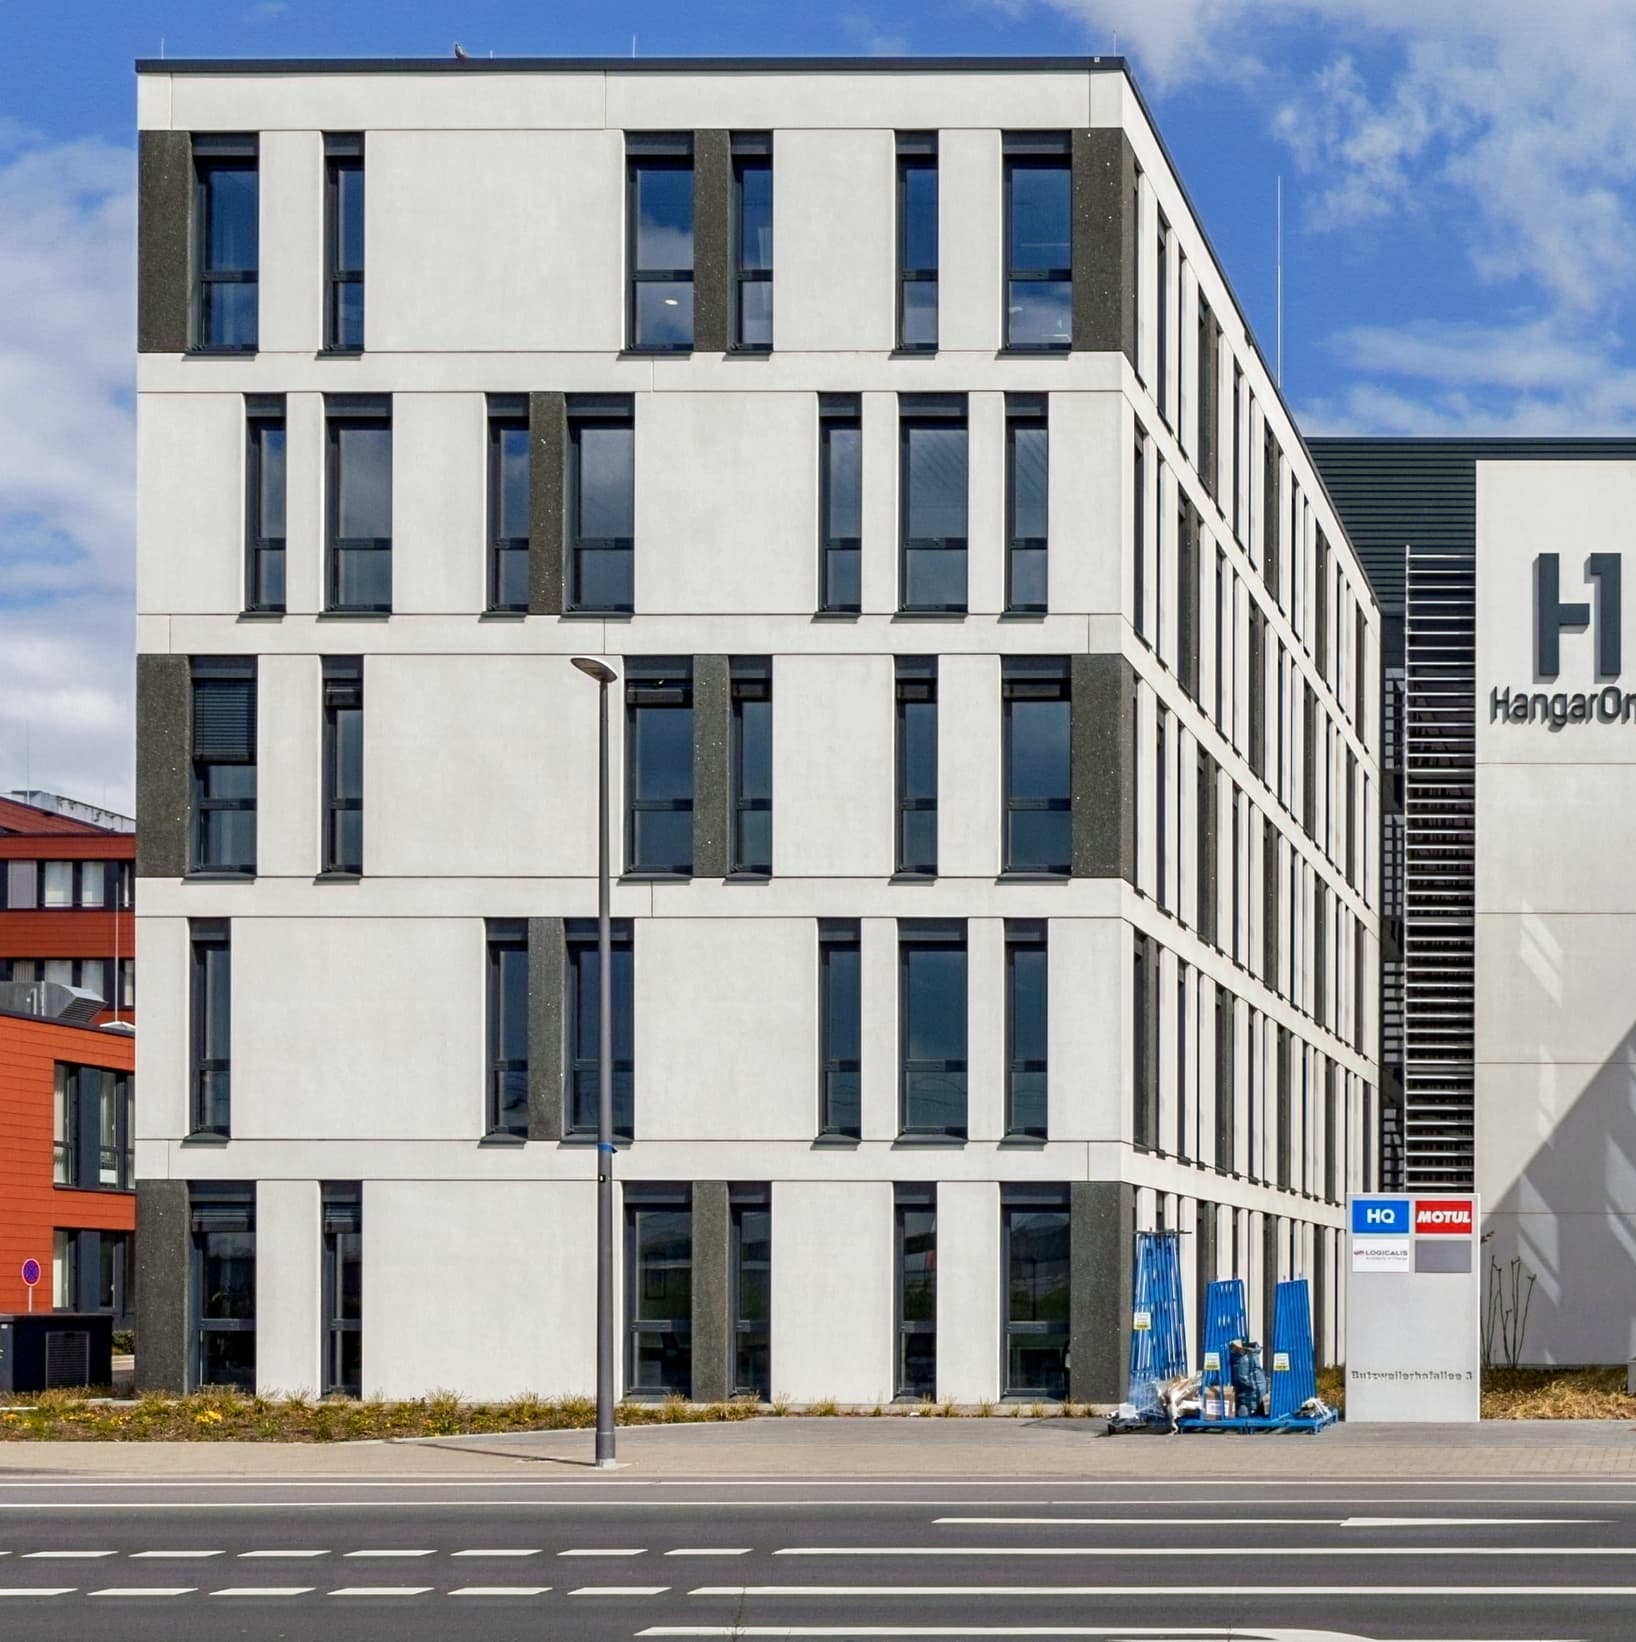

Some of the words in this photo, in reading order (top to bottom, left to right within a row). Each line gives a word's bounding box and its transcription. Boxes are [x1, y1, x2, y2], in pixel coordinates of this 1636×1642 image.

[1367, 1208, 1395, 1223] HQ
[1416, 1211, 1471, 1223] MOTUL
[1465, 1371, 1473, 1381] 3
